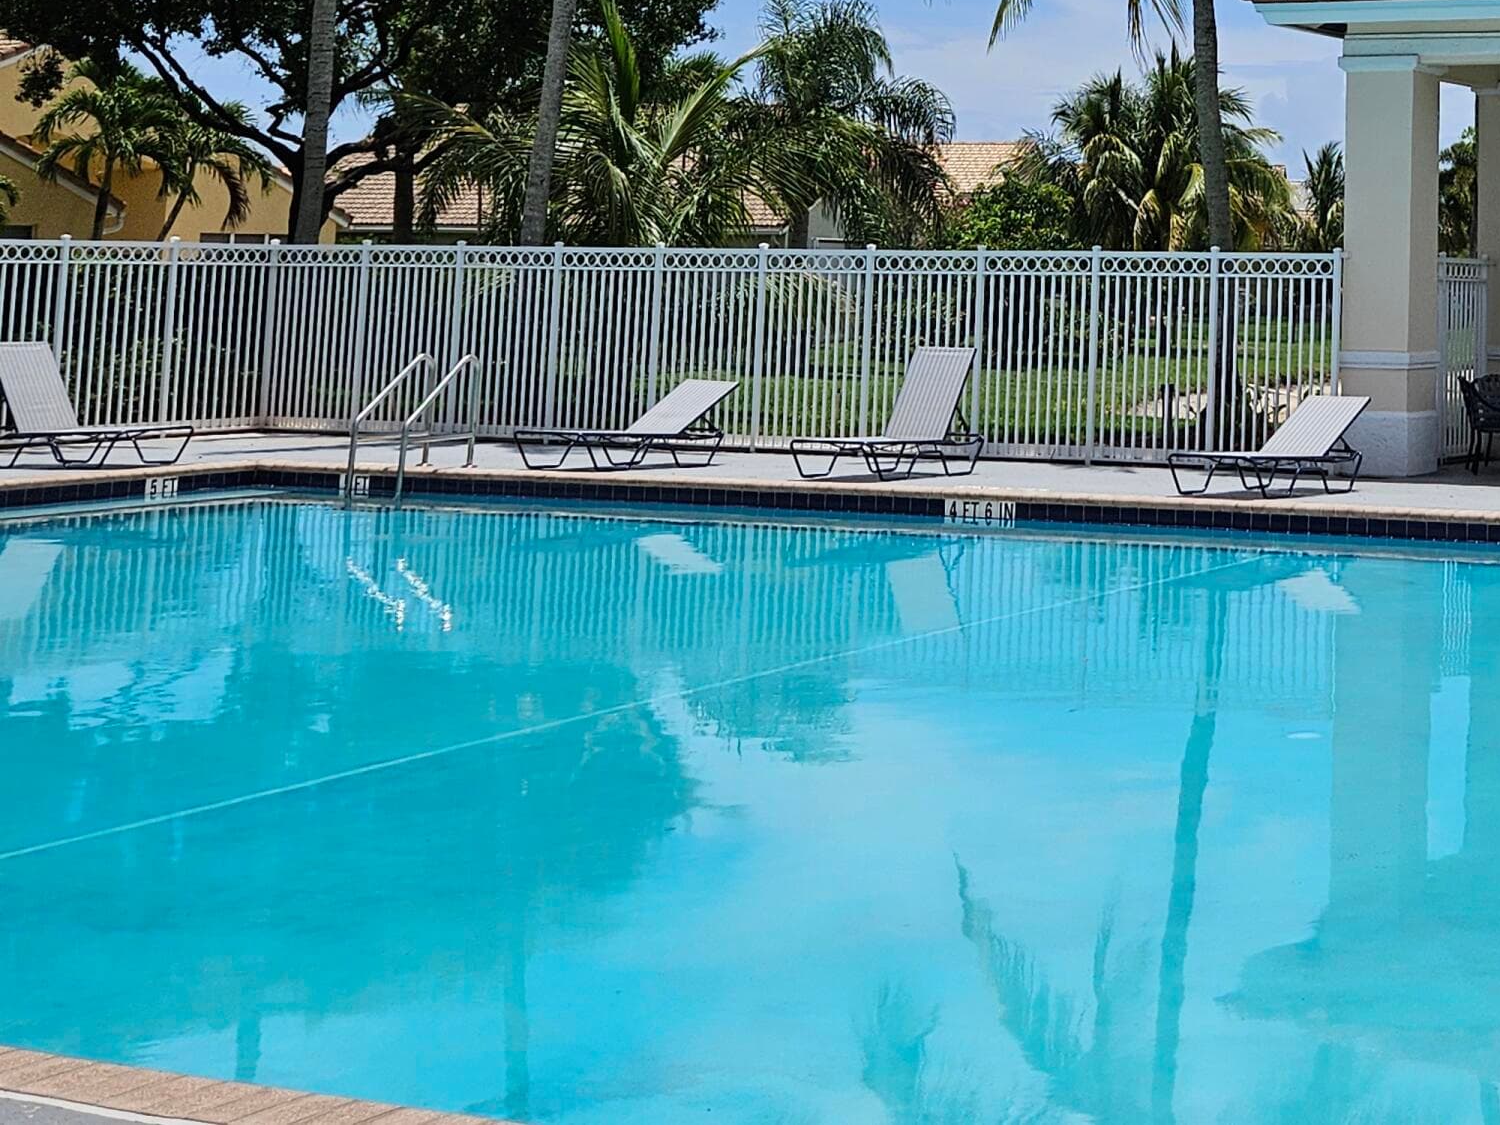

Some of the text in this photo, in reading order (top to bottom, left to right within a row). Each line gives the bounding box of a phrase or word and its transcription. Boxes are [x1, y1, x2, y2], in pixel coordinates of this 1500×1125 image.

[150, 477, 177, 496] 5 FT
[354, 475, 369, 491] FT
[949, 500, 1014, 520] 4 FT 6 IN
